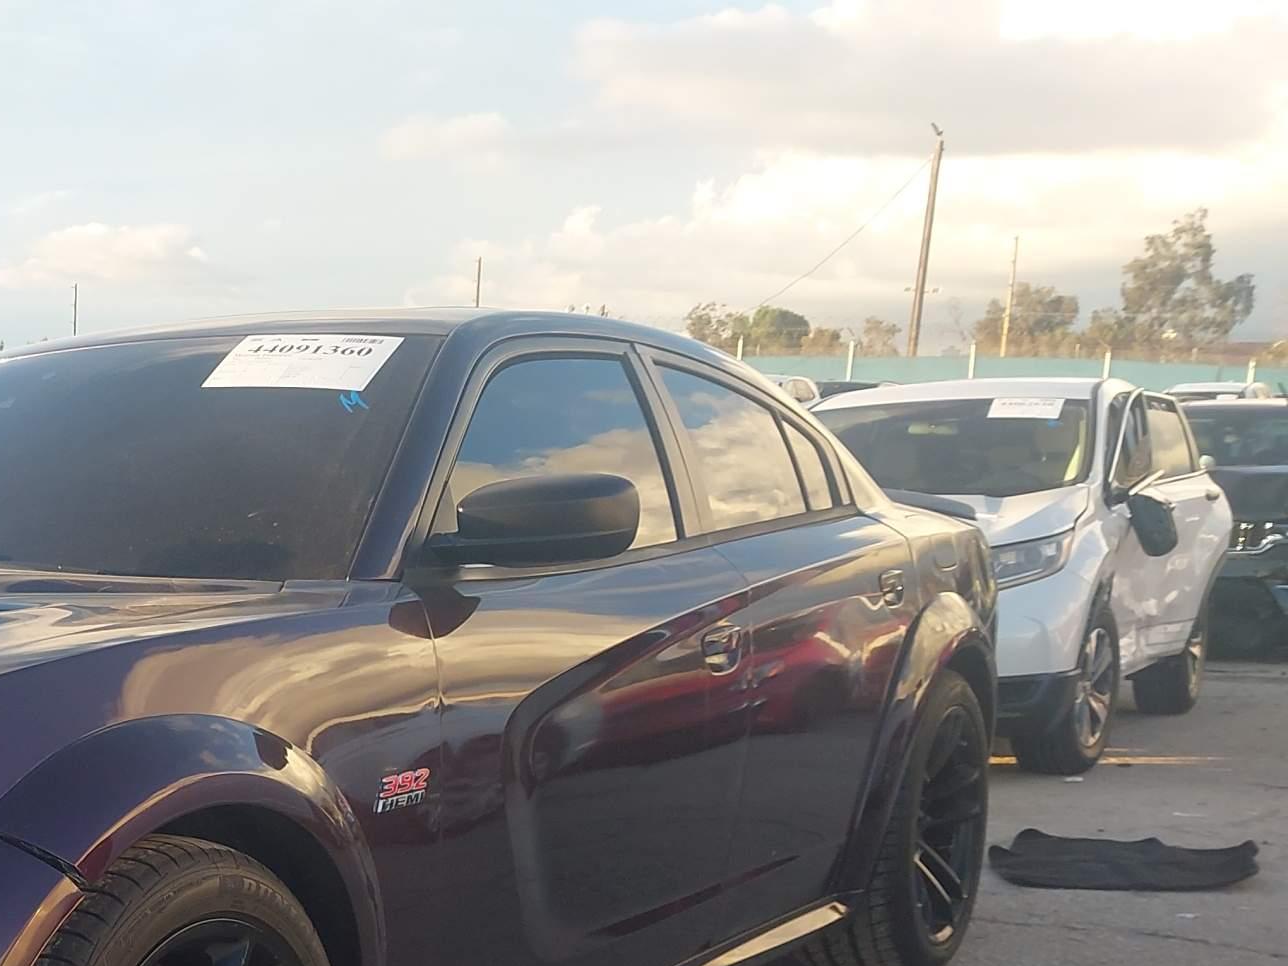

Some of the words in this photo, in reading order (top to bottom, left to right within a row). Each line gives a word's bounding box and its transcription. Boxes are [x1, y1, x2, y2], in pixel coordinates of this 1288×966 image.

[247, 343, 374, 357] 44091360
[379, 767, 431, 799] 392
[375, 789, 426, 813] HEMI
